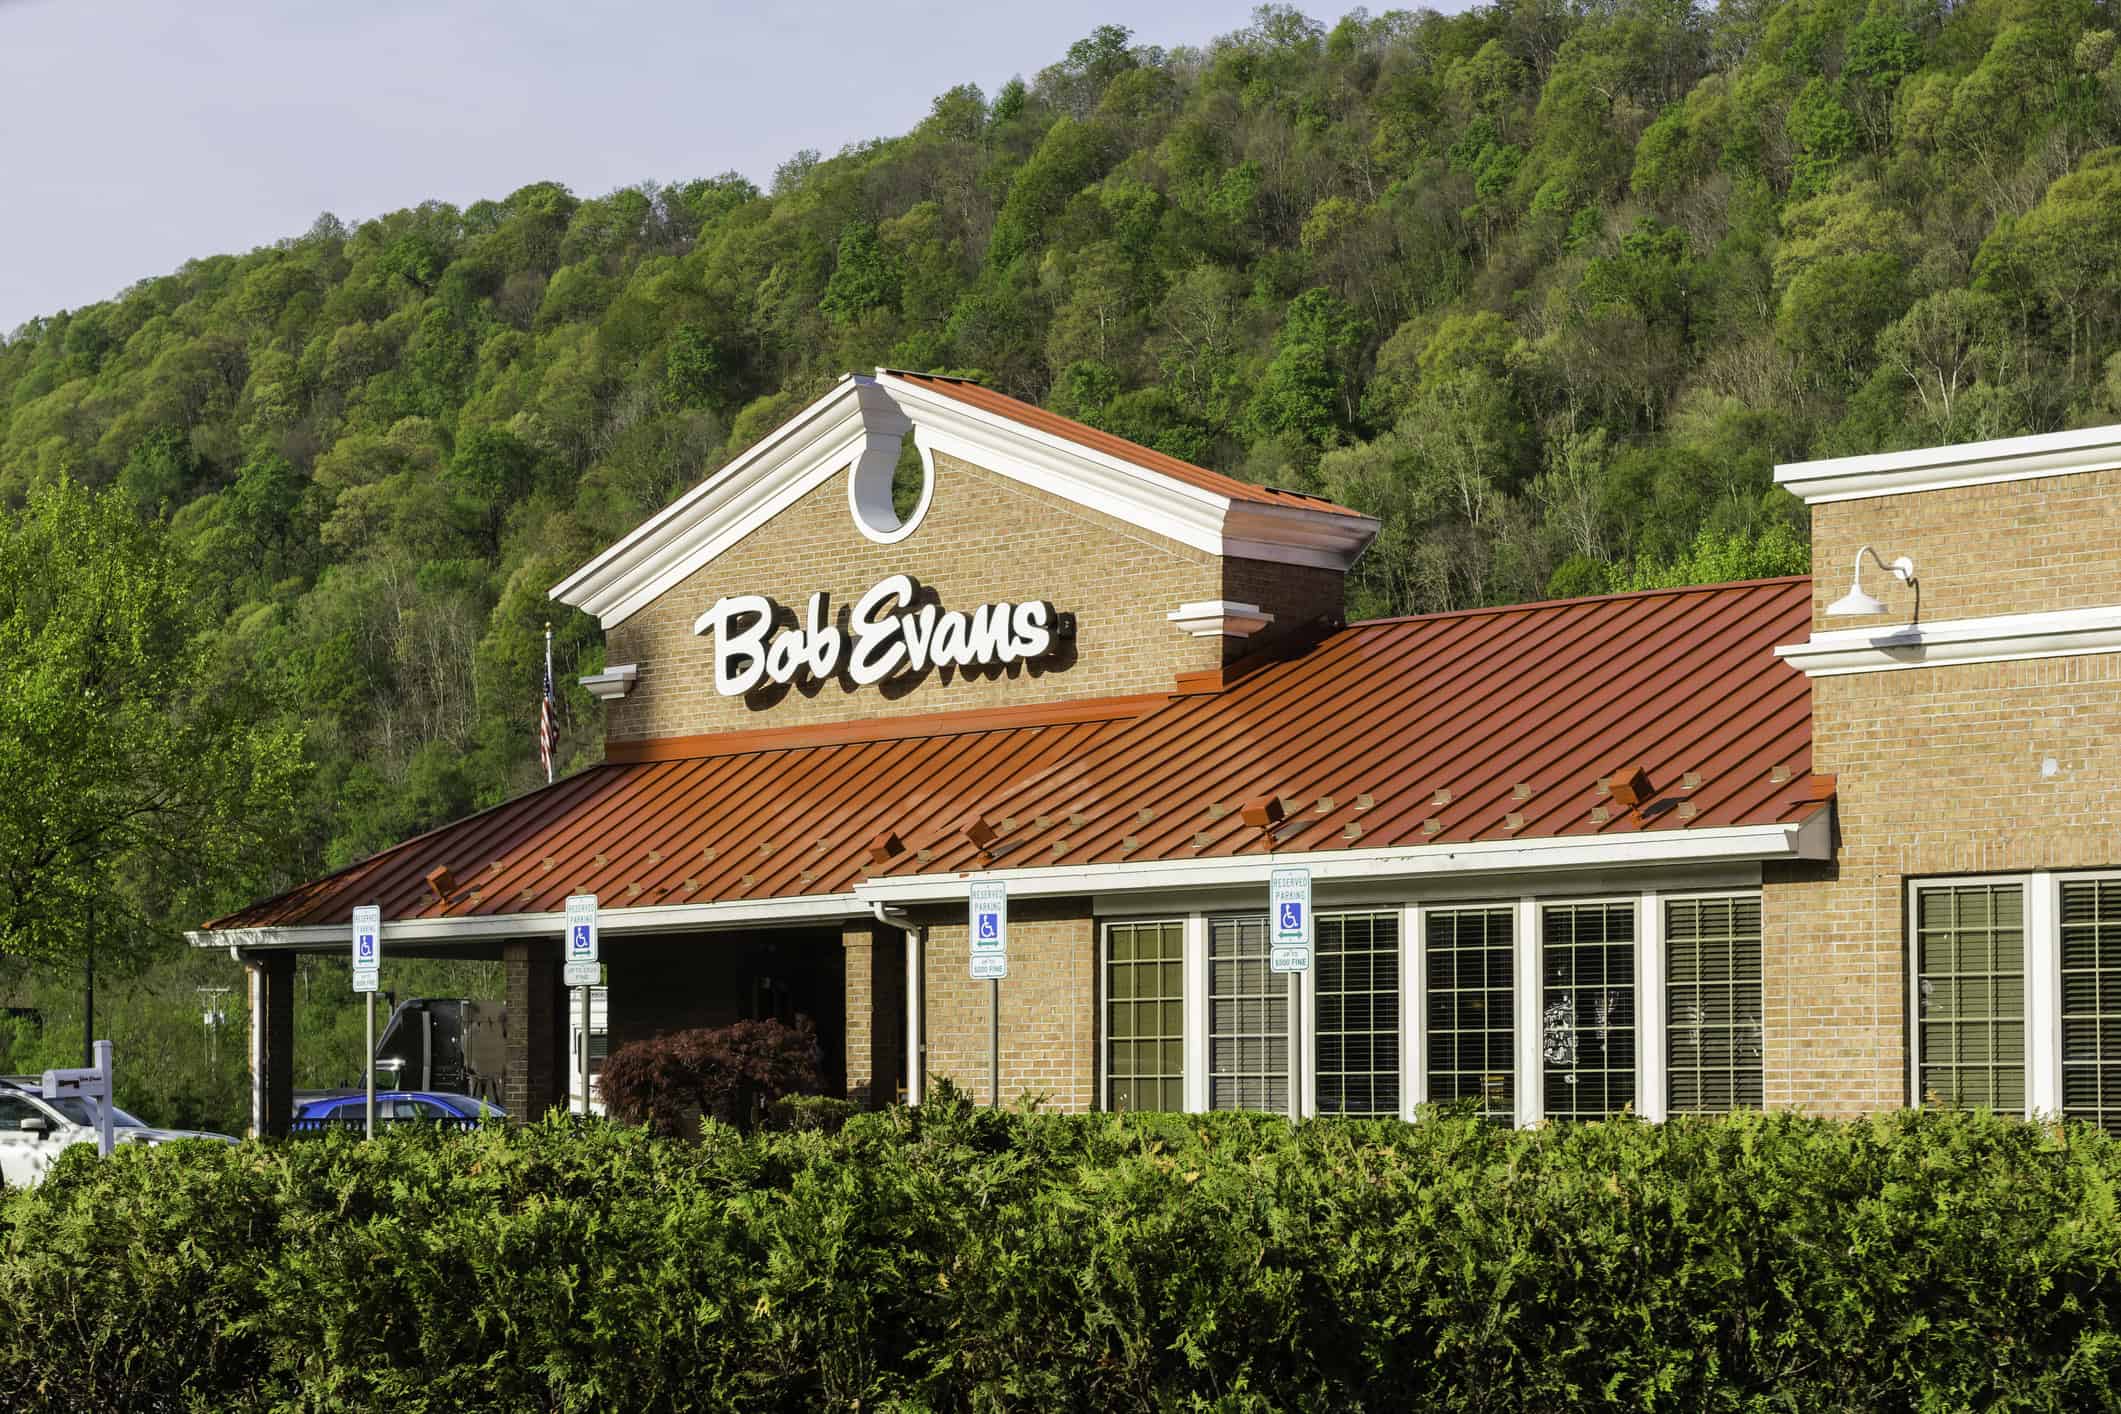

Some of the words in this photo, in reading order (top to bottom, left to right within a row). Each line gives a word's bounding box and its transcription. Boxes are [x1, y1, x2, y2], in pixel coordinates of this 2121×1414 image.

[694, 591, 844, 697] Bob
[848, 574, 1055, 685] Evans
[1273, 878, 1308, 888] RESERVED
[973, 889, 1003, 899] RESERVED
[1275, 890, 1305, 899] PARKING
[567, 903, 594, 912] RESERVED
[975, 902, 1001, 911] PARKING
[569, 914, 593, 923] PARKING
[1292, 957, 1306, 966] FINE
[989, 964, 1003, 973] FINE
